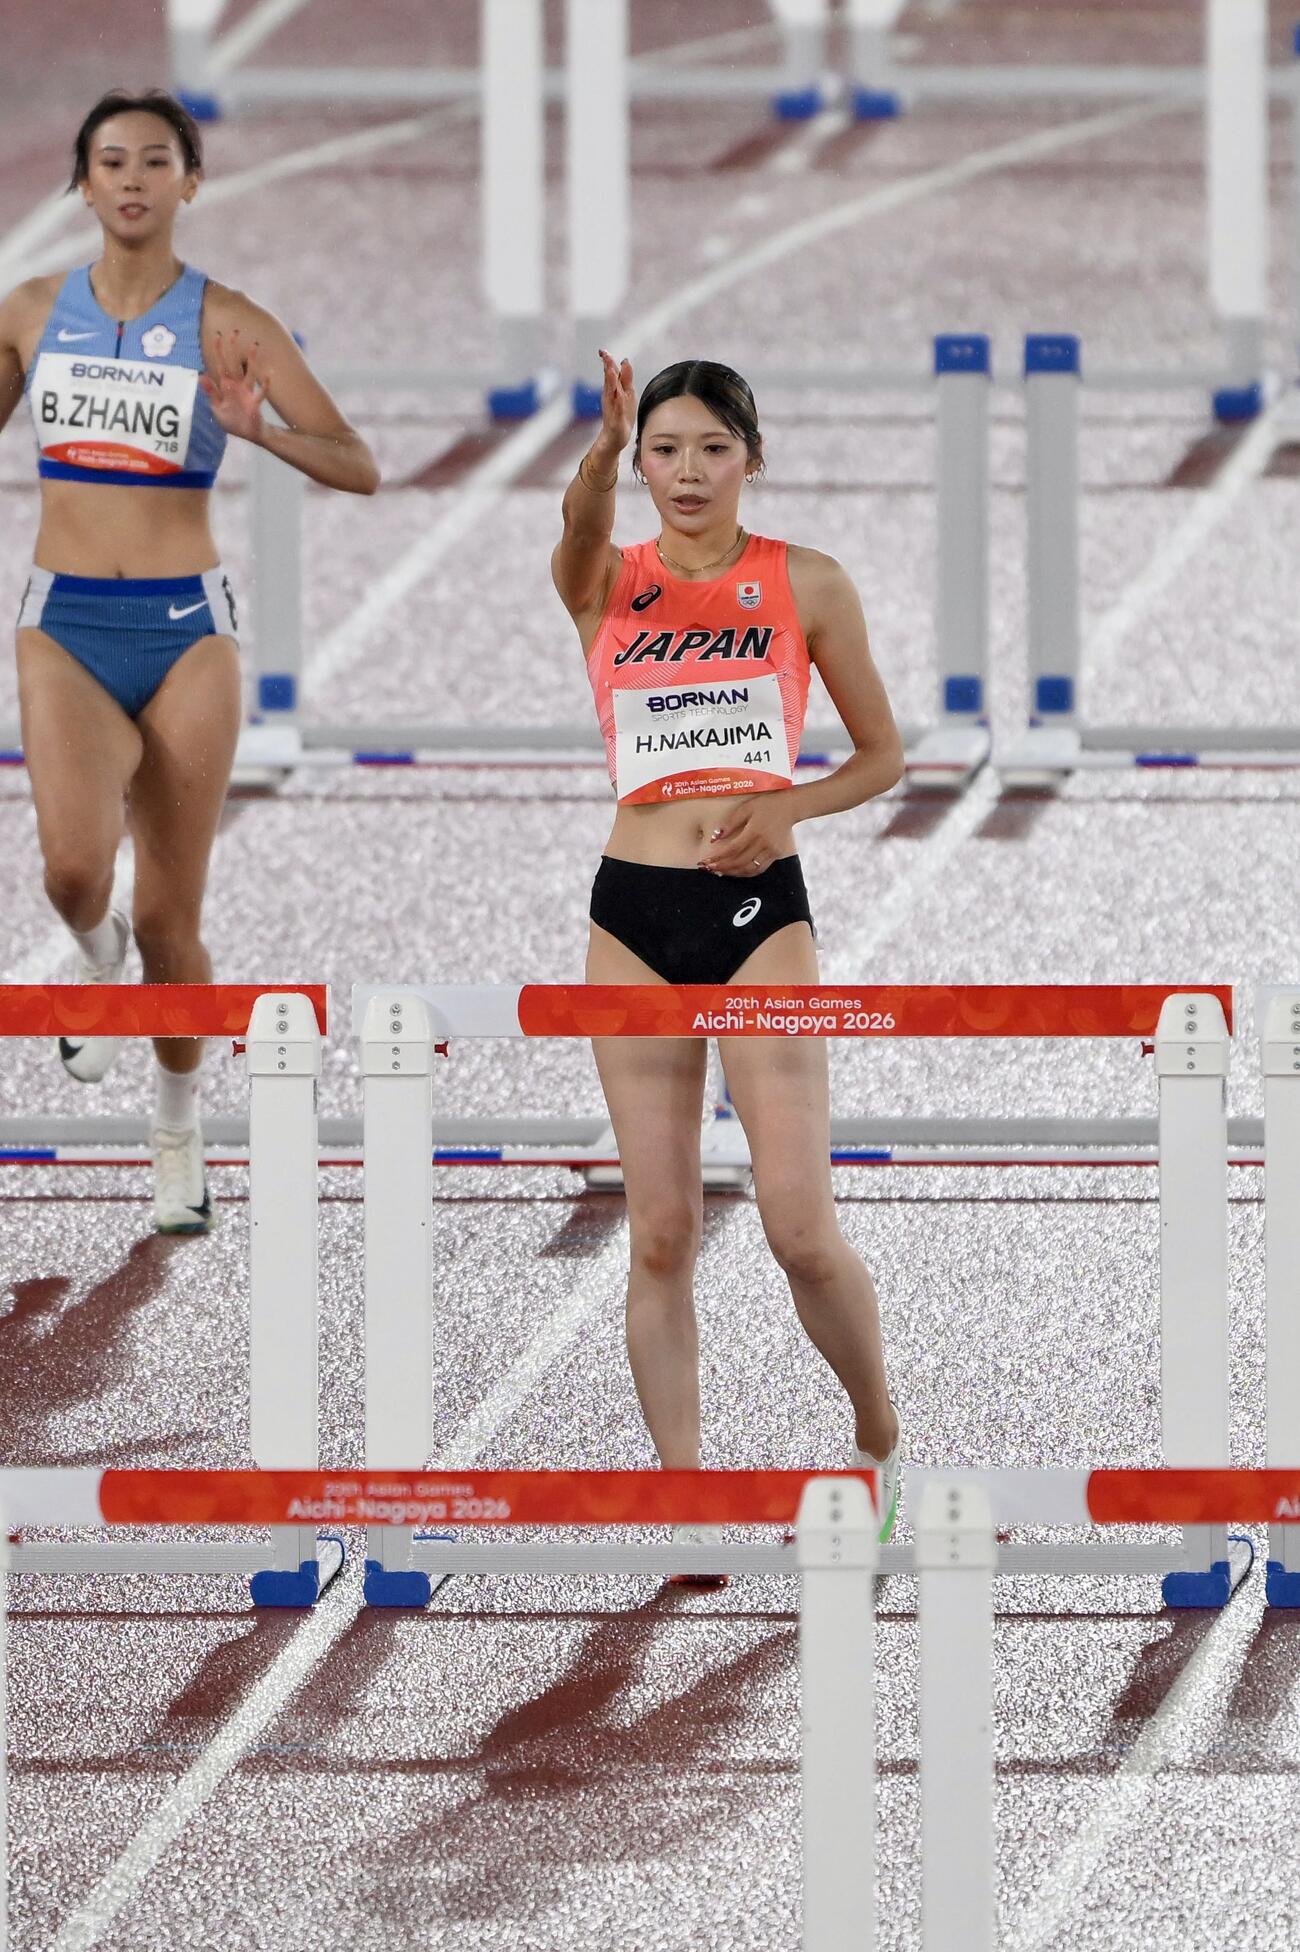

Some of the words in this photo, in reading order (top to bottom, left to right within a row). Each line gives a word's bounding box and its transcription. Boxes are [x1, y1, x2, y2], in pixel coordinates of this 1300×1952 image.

[70, 363, 164, 386] BORNAN
[42, 390, 179, 438] B.ZHANG
[155, 440, 178, 453] 718
[613, 626, 774, 667] JAPAN
[646, 688, 749, 713] BORNAN
[652, 710, 686, 722] SPORTS
[690, 704, 749, 717] TECHNOLOGY
[636, 722, 772, 753] H.NAKAJIMA
[743, 750, 771, 764] 441
[675, 783, 731, 796] Aichi-Nagoya
[733, 780, 754, 789] 2026
[725, 997, 759, 1009] 20th
[764, 997, 804, 1009] Asian
[808, 997, 862, 1009] Games
[692, 1011, 837, 1034] Aichi-Nagoya
[843, 1013, 896, 1030] 2026
[288, 1497, 447, 1523] Aichi-Nagoya
[453, 1498, 511, 1519] 2026
